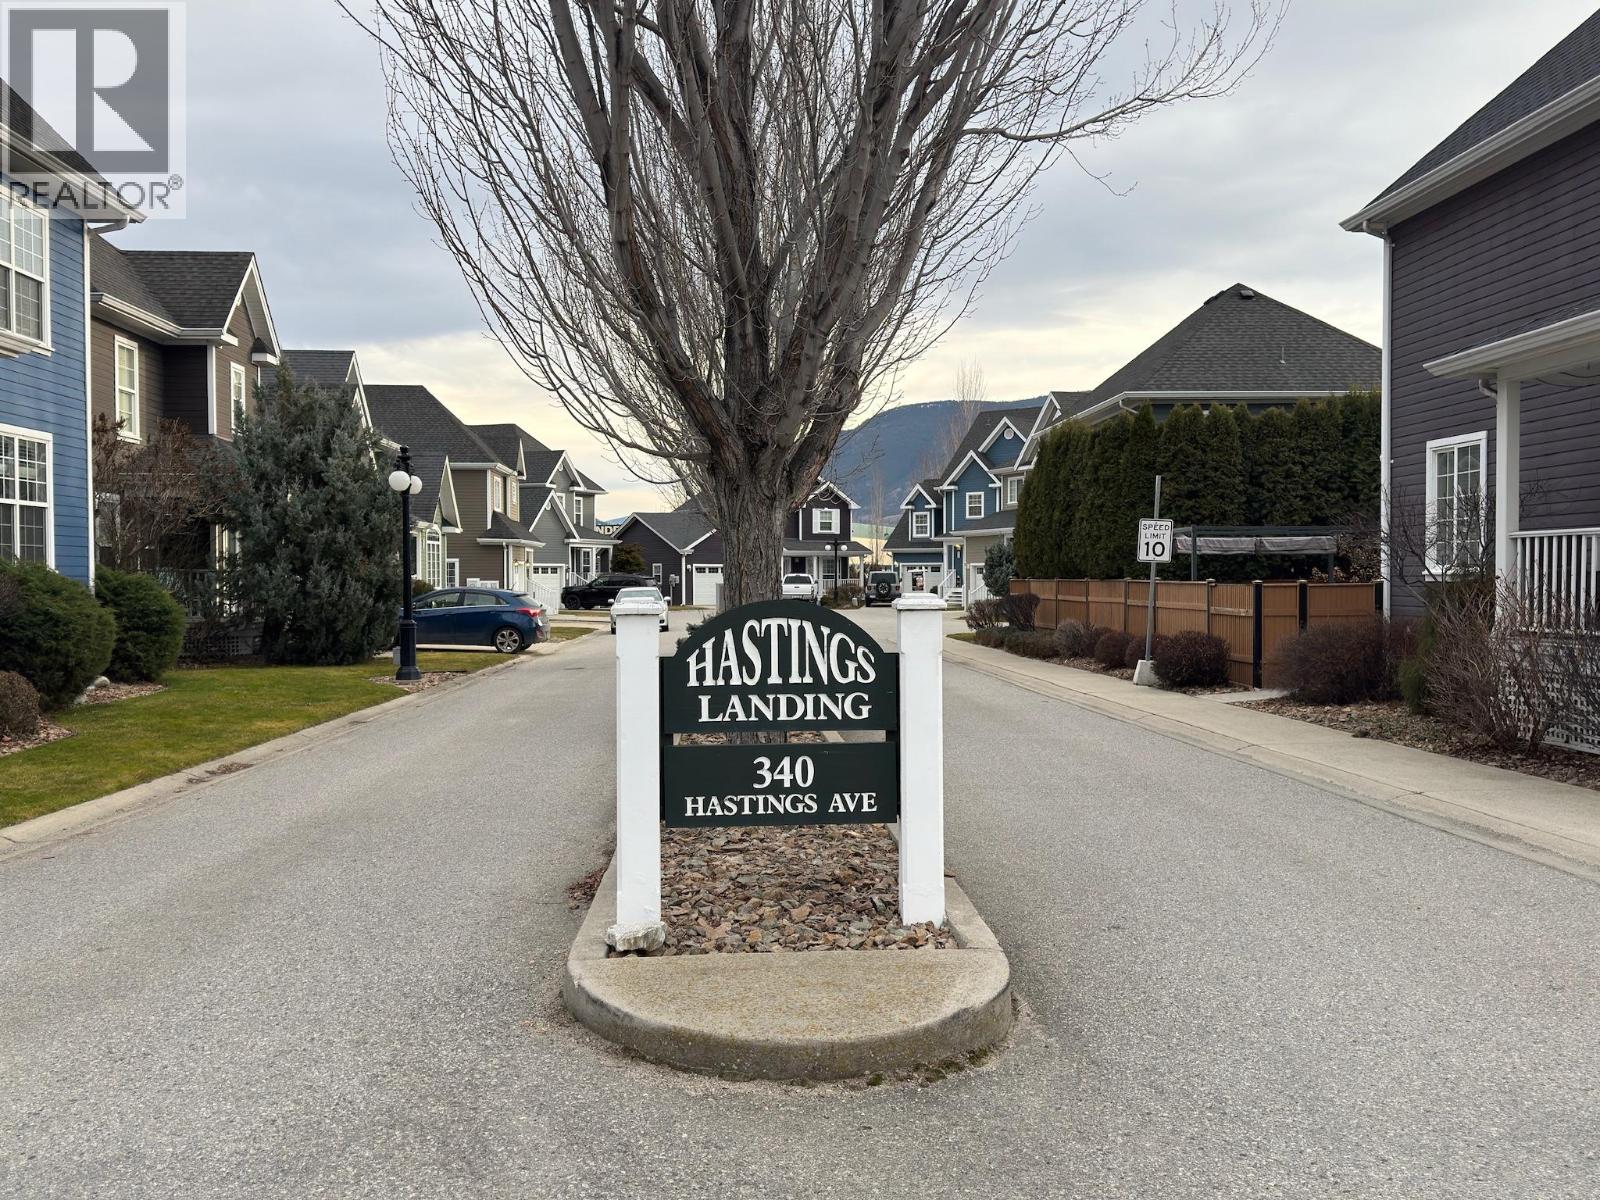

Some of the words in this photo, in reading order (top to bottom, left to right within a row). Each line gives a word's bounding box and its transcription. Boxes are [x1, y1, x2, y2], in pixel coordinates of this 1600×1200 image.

[1144, 541, 1165, 557] 10
[686, 617, 877, 687] HASTINGS
[698, 692, 872, 723] LANDING
[752, 755, 815, 789] 340
[684, 793, 818, 817] HASTINGS
[828, 792, 878, 813] AVE
